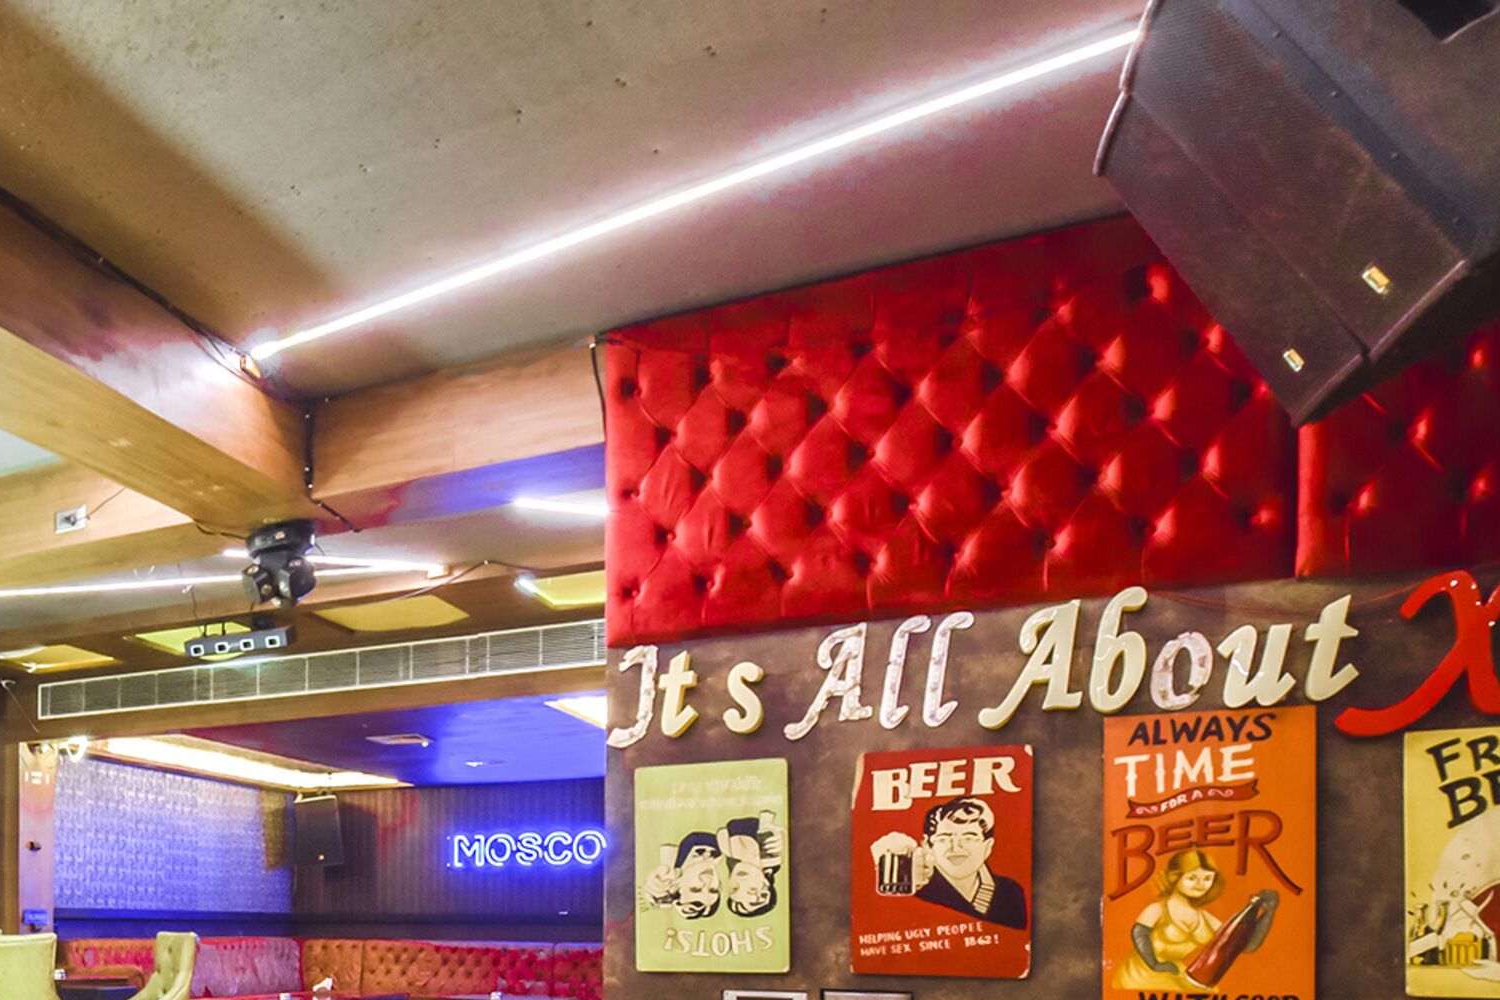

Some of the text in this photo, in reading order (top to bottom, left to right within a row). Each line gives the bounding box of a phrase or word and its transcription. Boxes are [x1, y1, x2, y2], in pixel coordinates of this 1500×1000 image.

[783, 611, 975, 741] All
[977, 586, 1361, 730] About
[1128, 713, 1277, 746] ALWAYS
[871, 756, 1022, 811] BEER
[1114, 743, 1256, 798] TIME
[1160, 789, 1203, 812] FOR A
[453, 830, 607, 867] MOSCO
[1109, 810, 1303, 901] BEER
[663, 926, 774, 958] SHOTS!
[859, 931, 902, 945] HELPING
[904, 927, 931, 940] UGLY
[860, 945, 887, 956] HAVE
[891, 943, 912, 954] SEX
[919, 939, 951, 952] SINCE
